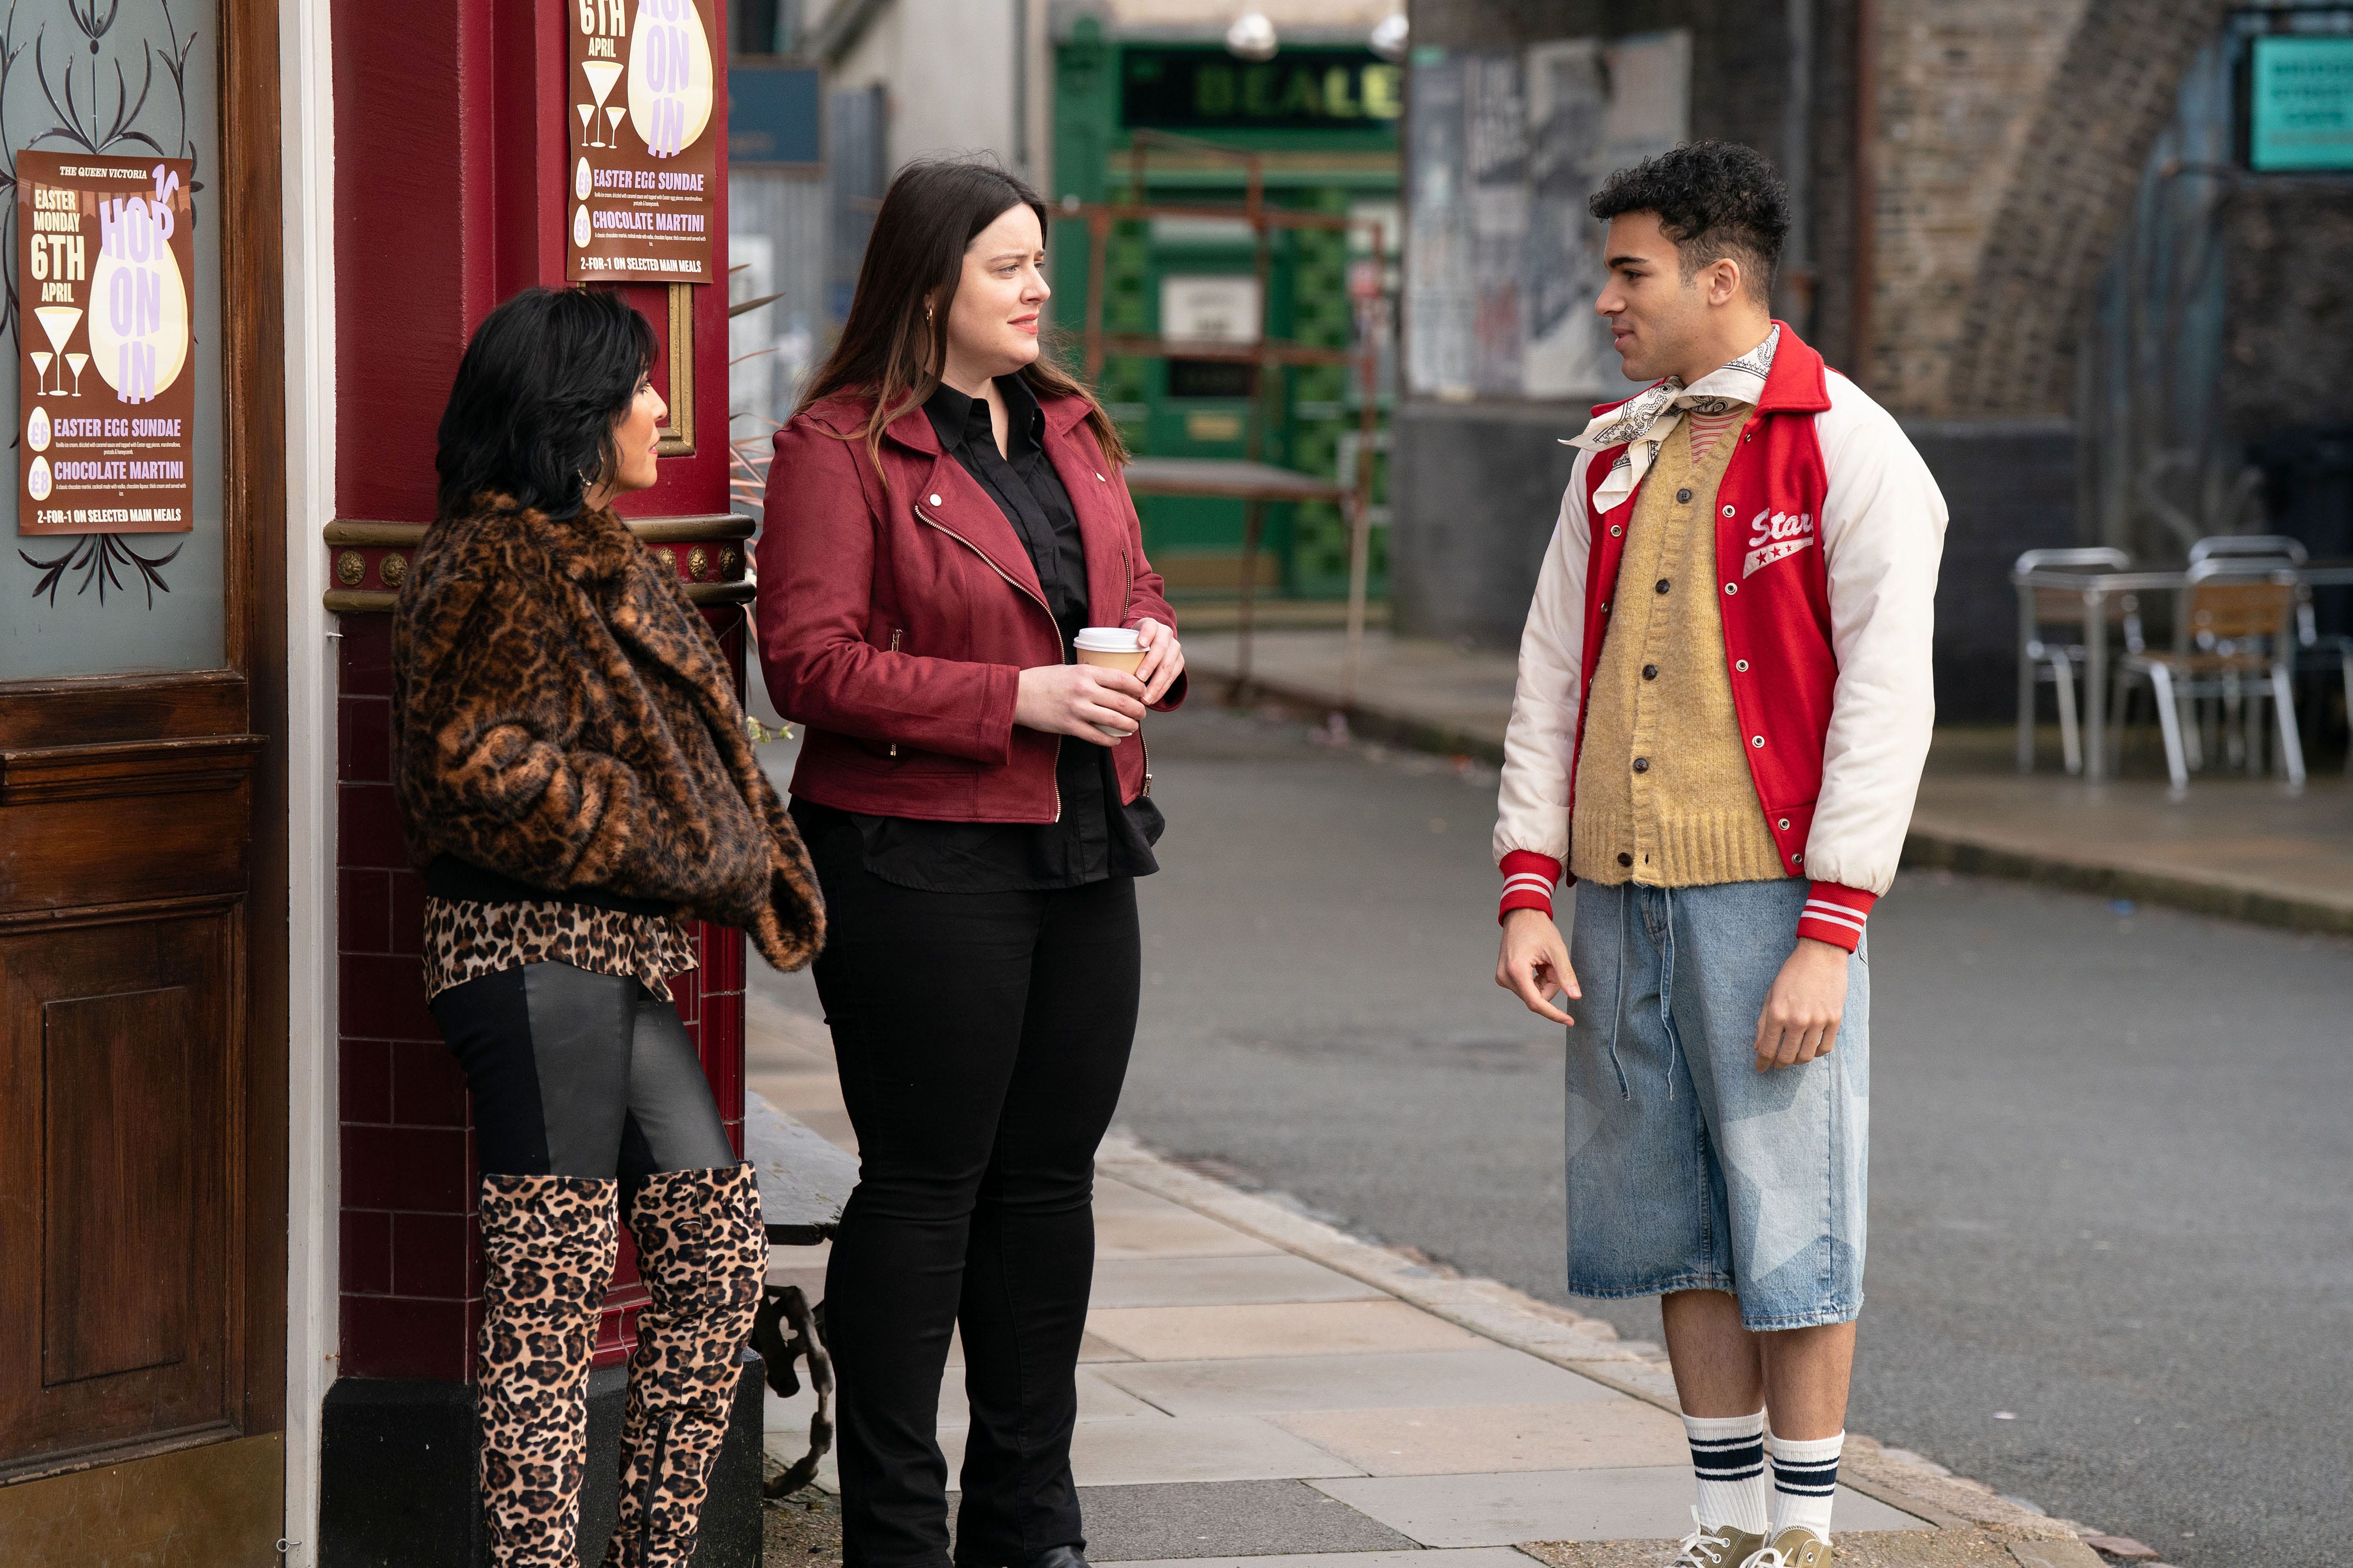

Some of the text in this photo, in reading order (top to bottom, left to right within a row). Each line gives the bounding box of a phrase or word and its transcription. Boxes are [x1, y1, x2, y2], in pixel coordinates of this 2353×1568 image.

[588, 37, 617, 58] APRIL
[646, 25, 690, 93] ON
[647, 97, 685, 159] IN
[60, 166, 147, 179] THE QUEEN VICTORIA
[578, 171, 590, 194] £6
[593, 169, 704, 192] EASTER EGG SUNDAE
[35, 189, 76, 211] EASTER
[33, 211, 81, 233] MONDAY
[99, 196, 175, 263] HOP
[575, 218, 589, 240] £8
[592, 210, 704, 232] CHOCOLATE MARTINI
[31, 233, 85, 281] 6TH
[580, 257, 702, 273] 2-FOR-1 ON SELECTED MAIN MEALS
[41, 282, 75, 302] APRIL
[110, 266, 161, 337] ON
[117, 341, 156, 404] IN
[31, 422, 49, 445] £6
[54, 419, 182, 437] EASTER EGG SUNDAE
[31, 470, 49, 493] £8
[54, 461, 184, 480] CHOCOLATE MARTINI
[37, 508, 182, 524] 2-FOR-1 ON SELECTED MAIN MEALS
